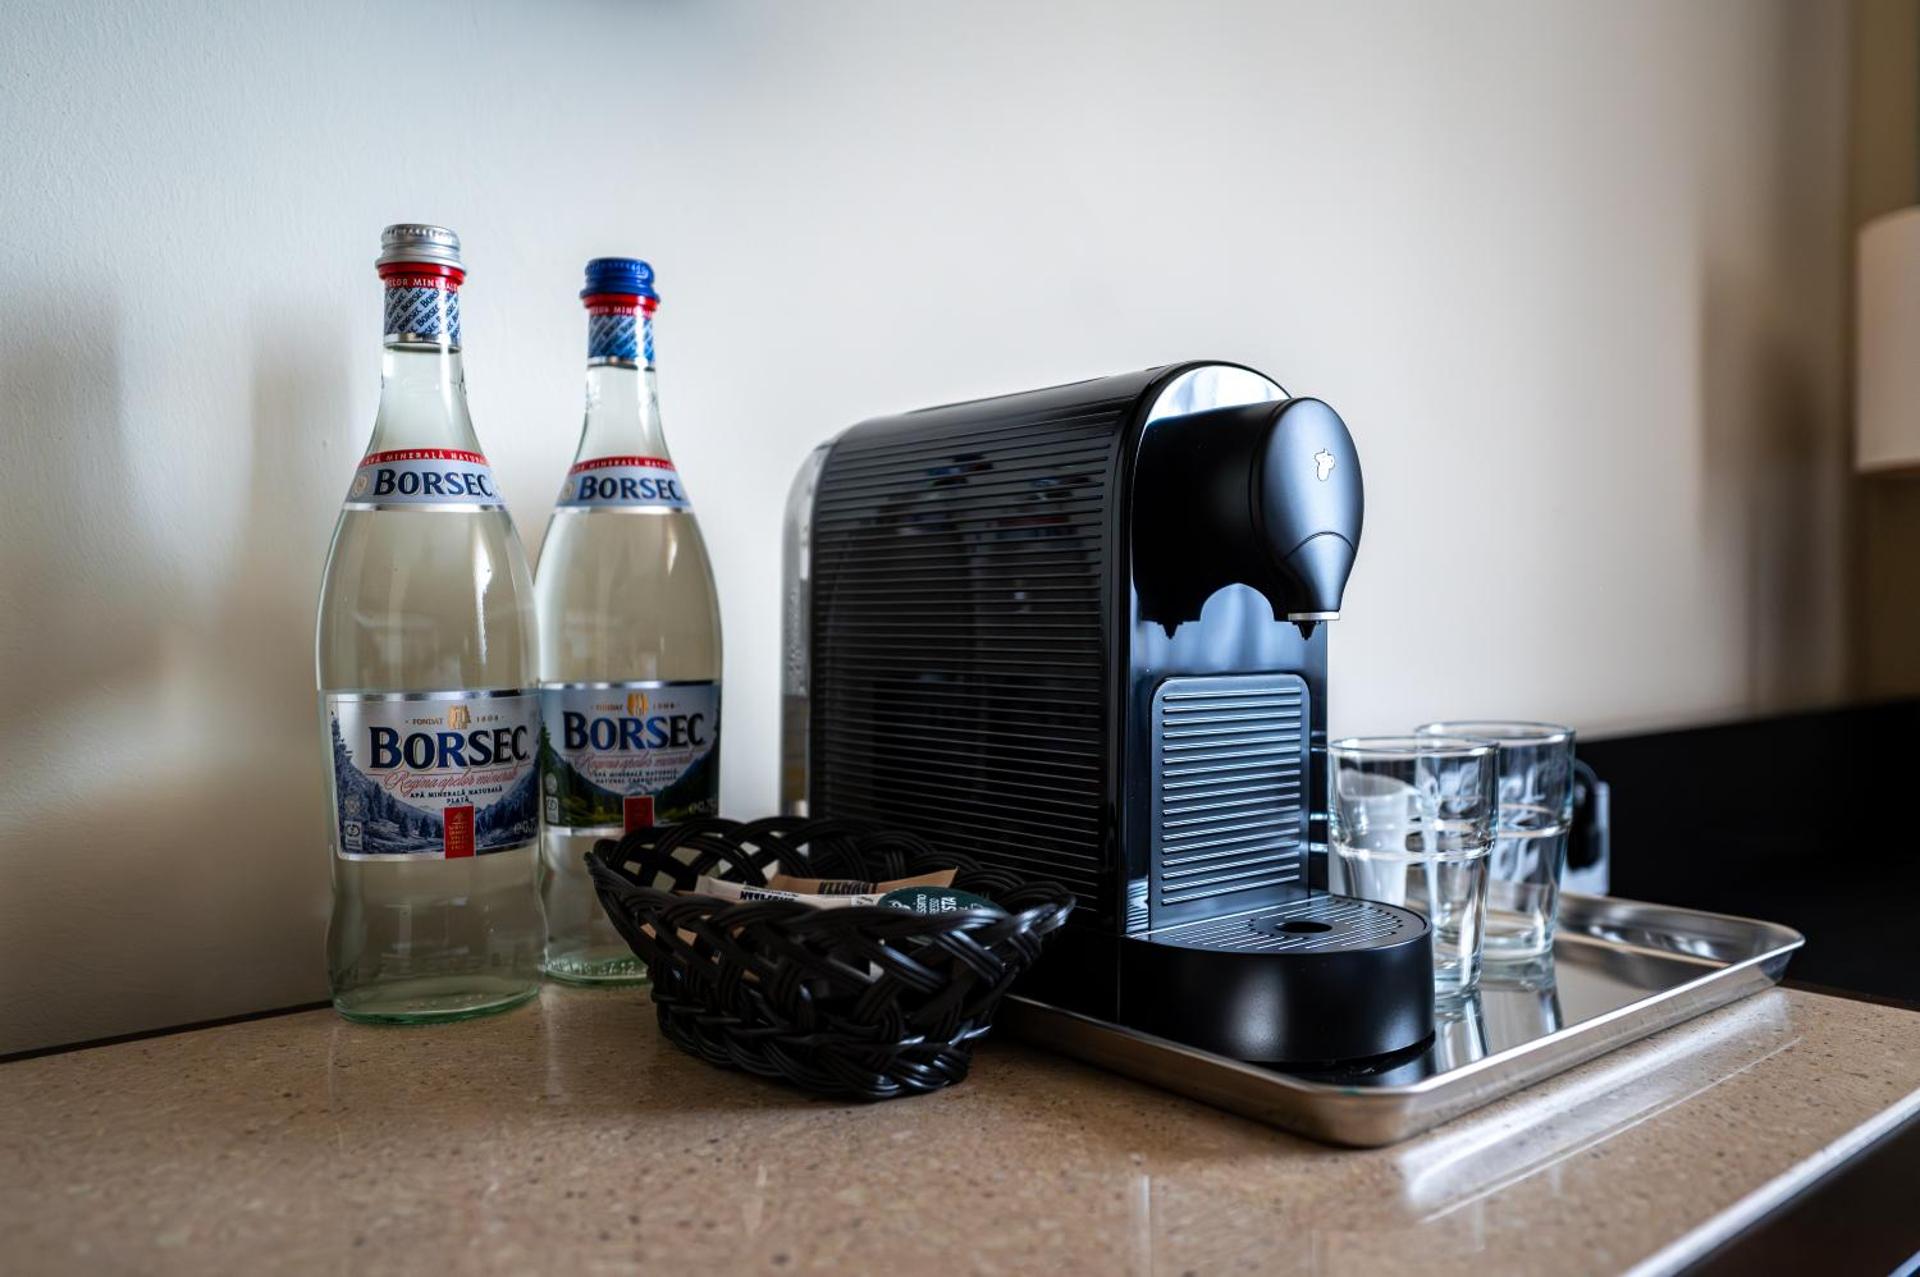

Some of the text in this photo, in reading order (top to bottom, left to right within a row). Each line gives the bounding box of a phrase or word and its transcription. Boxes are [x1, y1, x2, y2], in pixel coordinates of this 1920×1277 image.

[373, 468, 493, 497] BORSEC
[578, 475, 684, 502] BORSEC
[369, 725, 527, 770] BORSEC
[563, 711, 706, 750] BORSEC
